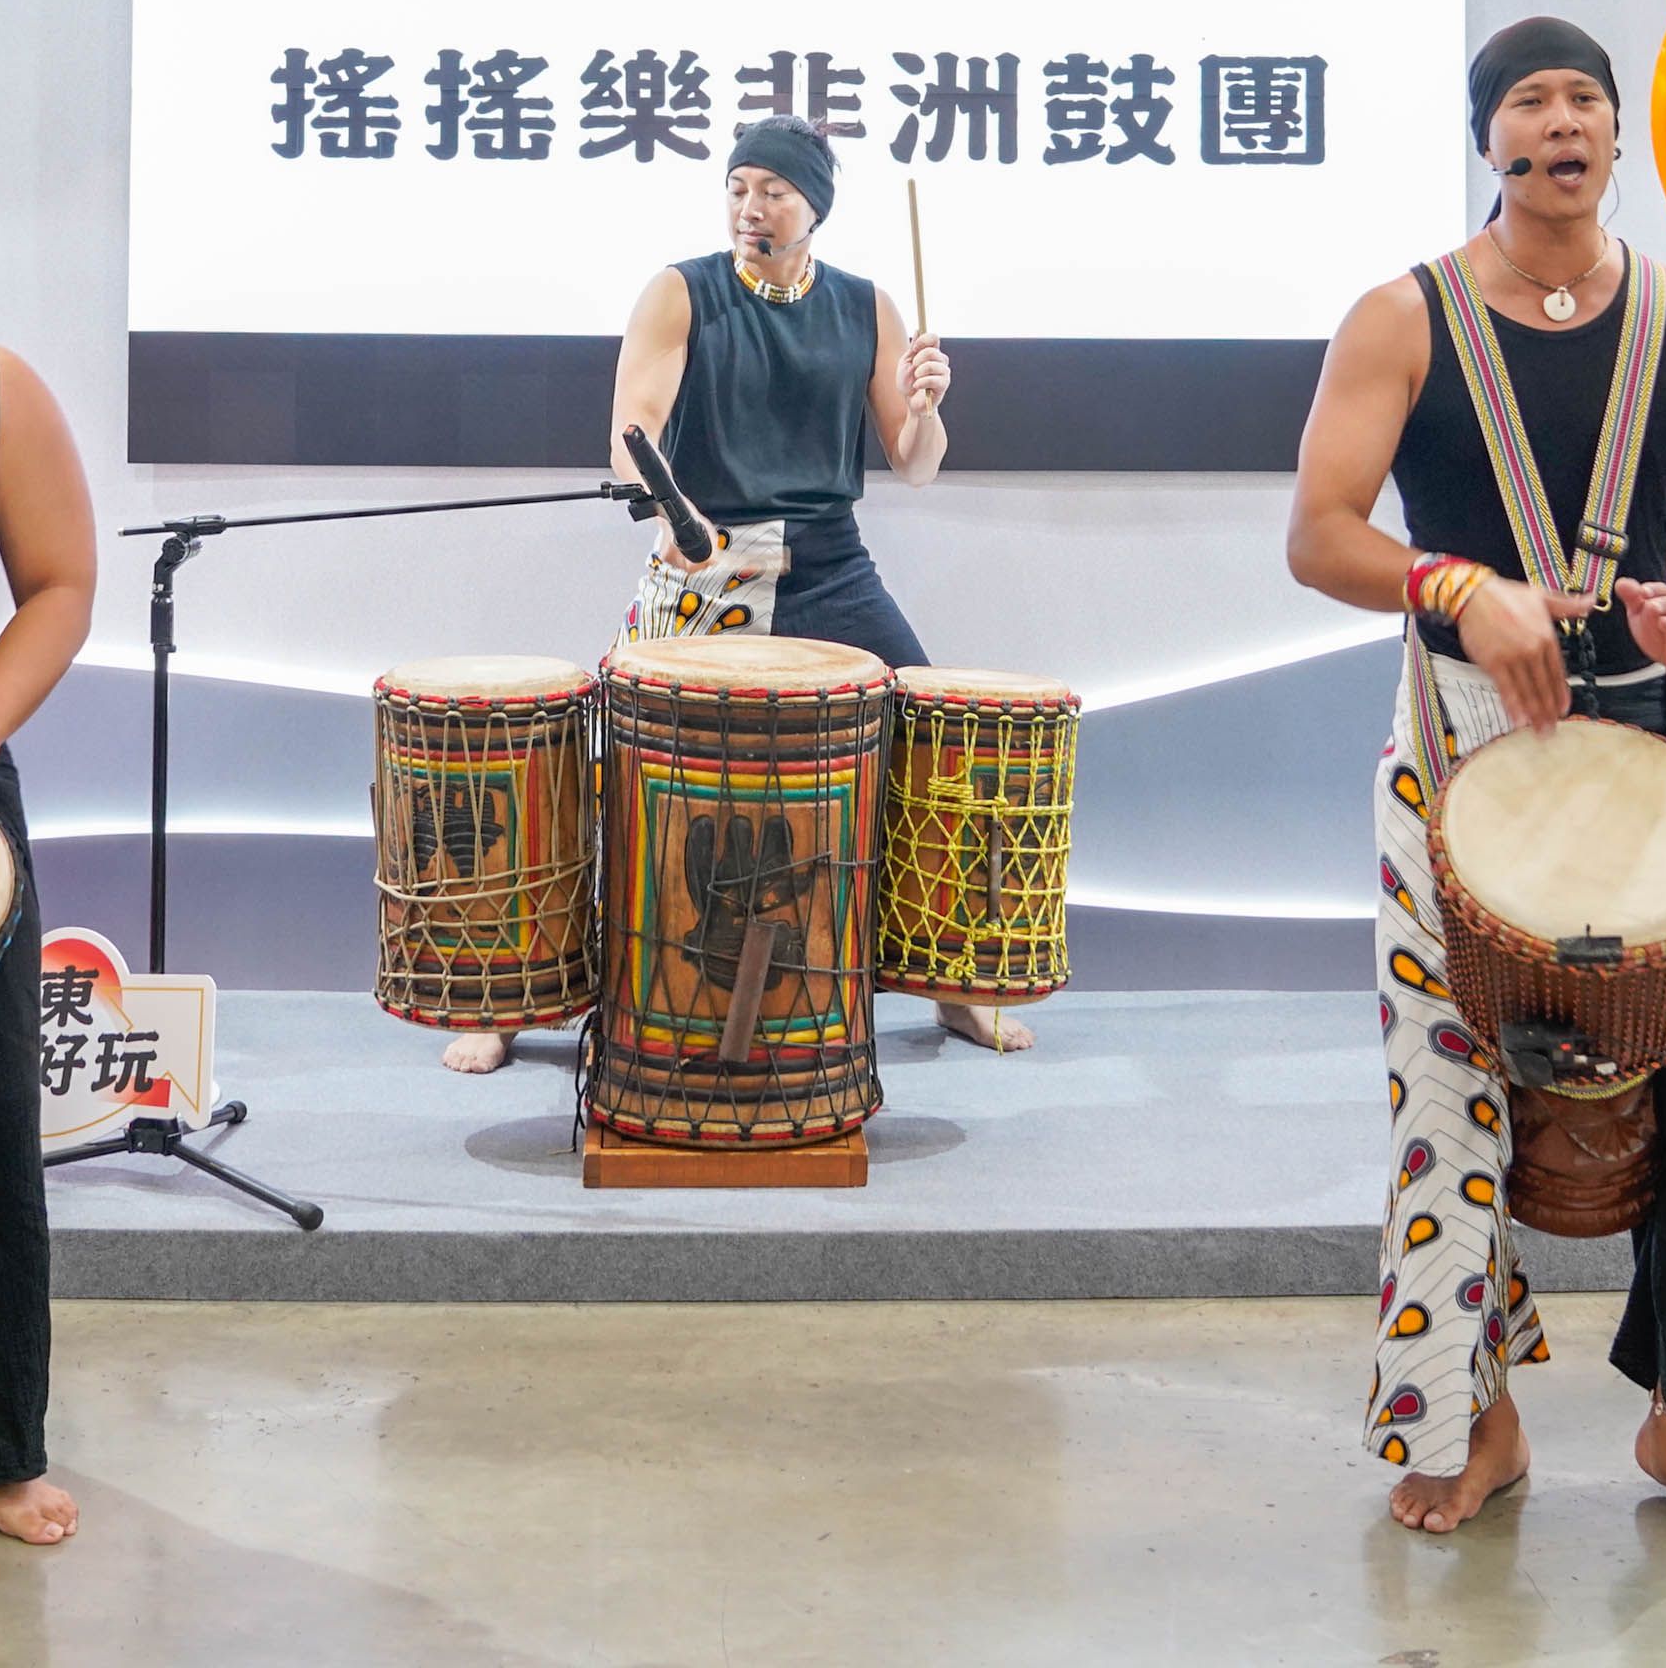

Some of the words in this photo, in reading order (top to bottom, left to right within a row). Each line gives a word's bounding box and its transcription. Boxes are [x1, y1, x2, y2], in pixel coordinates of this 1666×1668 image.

[271, 47, 1328, 167] 搖搖樂非洲鼓團
